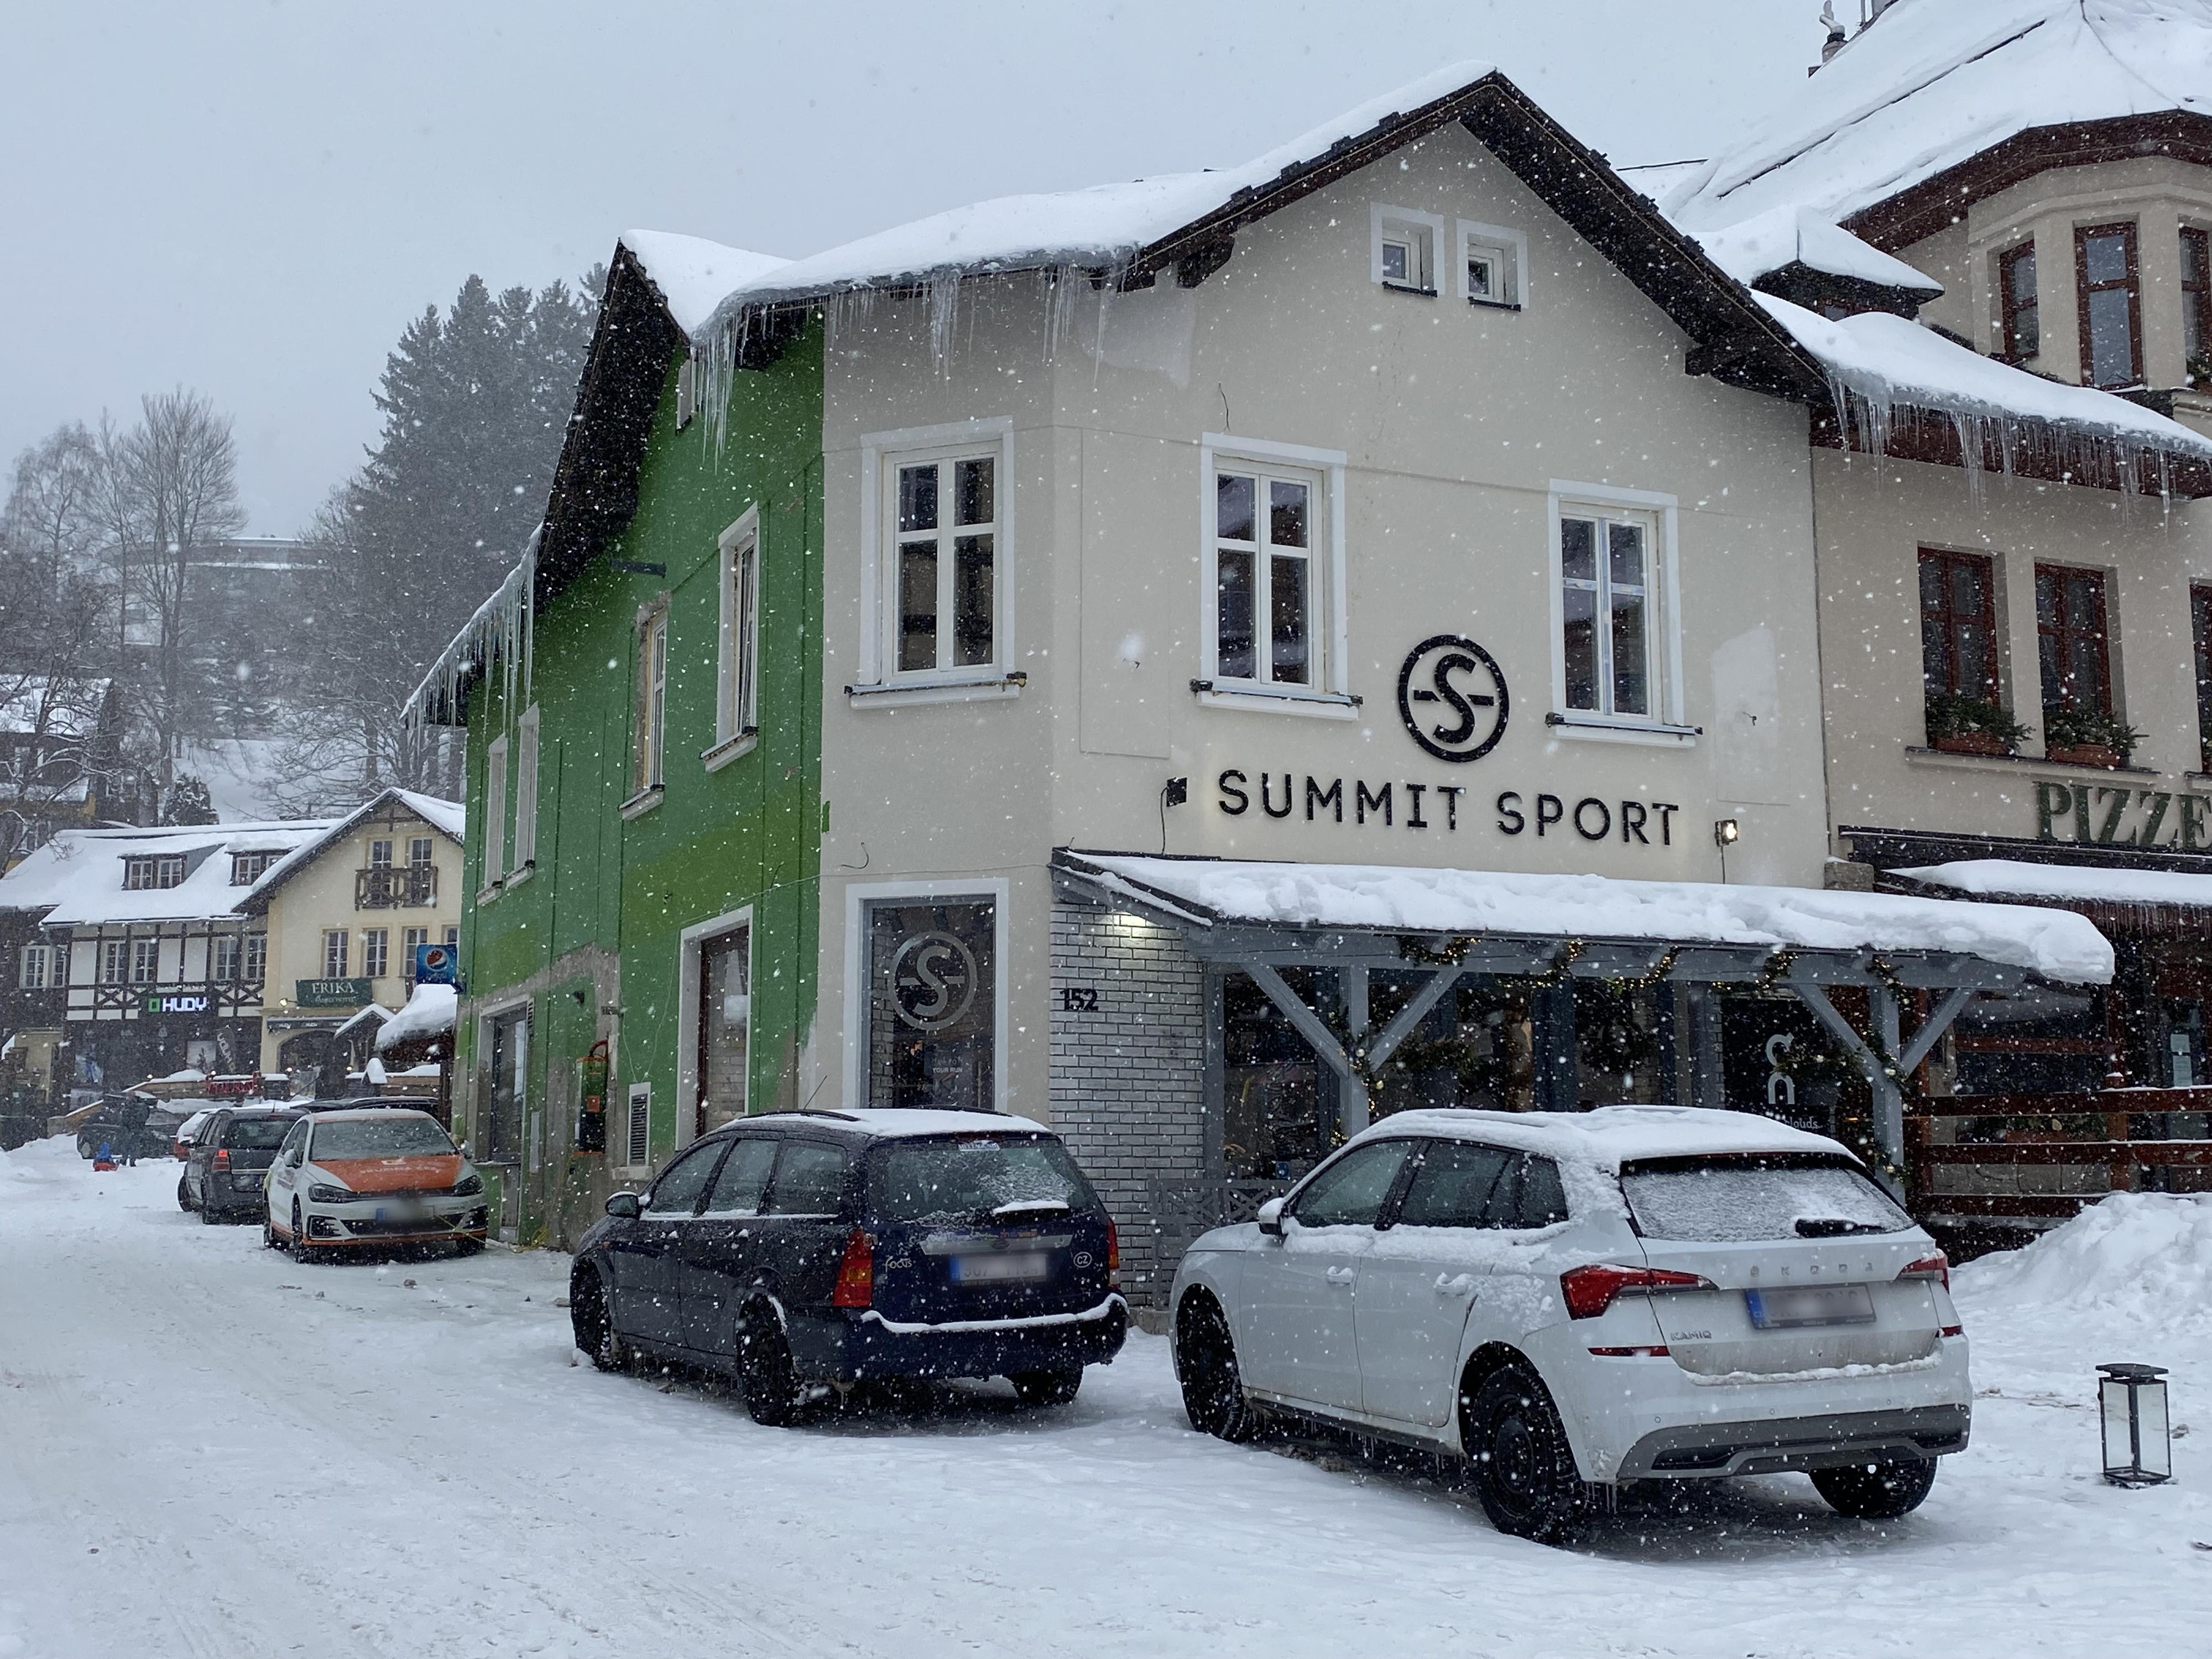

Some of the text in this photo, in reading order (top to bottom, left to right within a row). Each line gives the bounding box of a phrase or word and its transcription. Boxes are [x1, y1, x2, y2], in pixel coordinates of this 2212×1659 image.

[1218, 769, 1679, 846] SUMMIT SPORT
[2032, 780, 2212, 853] PIZZE
[312, 982, 354, 993] ERIKA
[162, 997, 207, 1012] HUDY
[1060, 988, 1099, 1011] 152
[1077, 1255, 1088, 1264] CZ
[1670, 1330, 1712, 1341] KAMIQ
